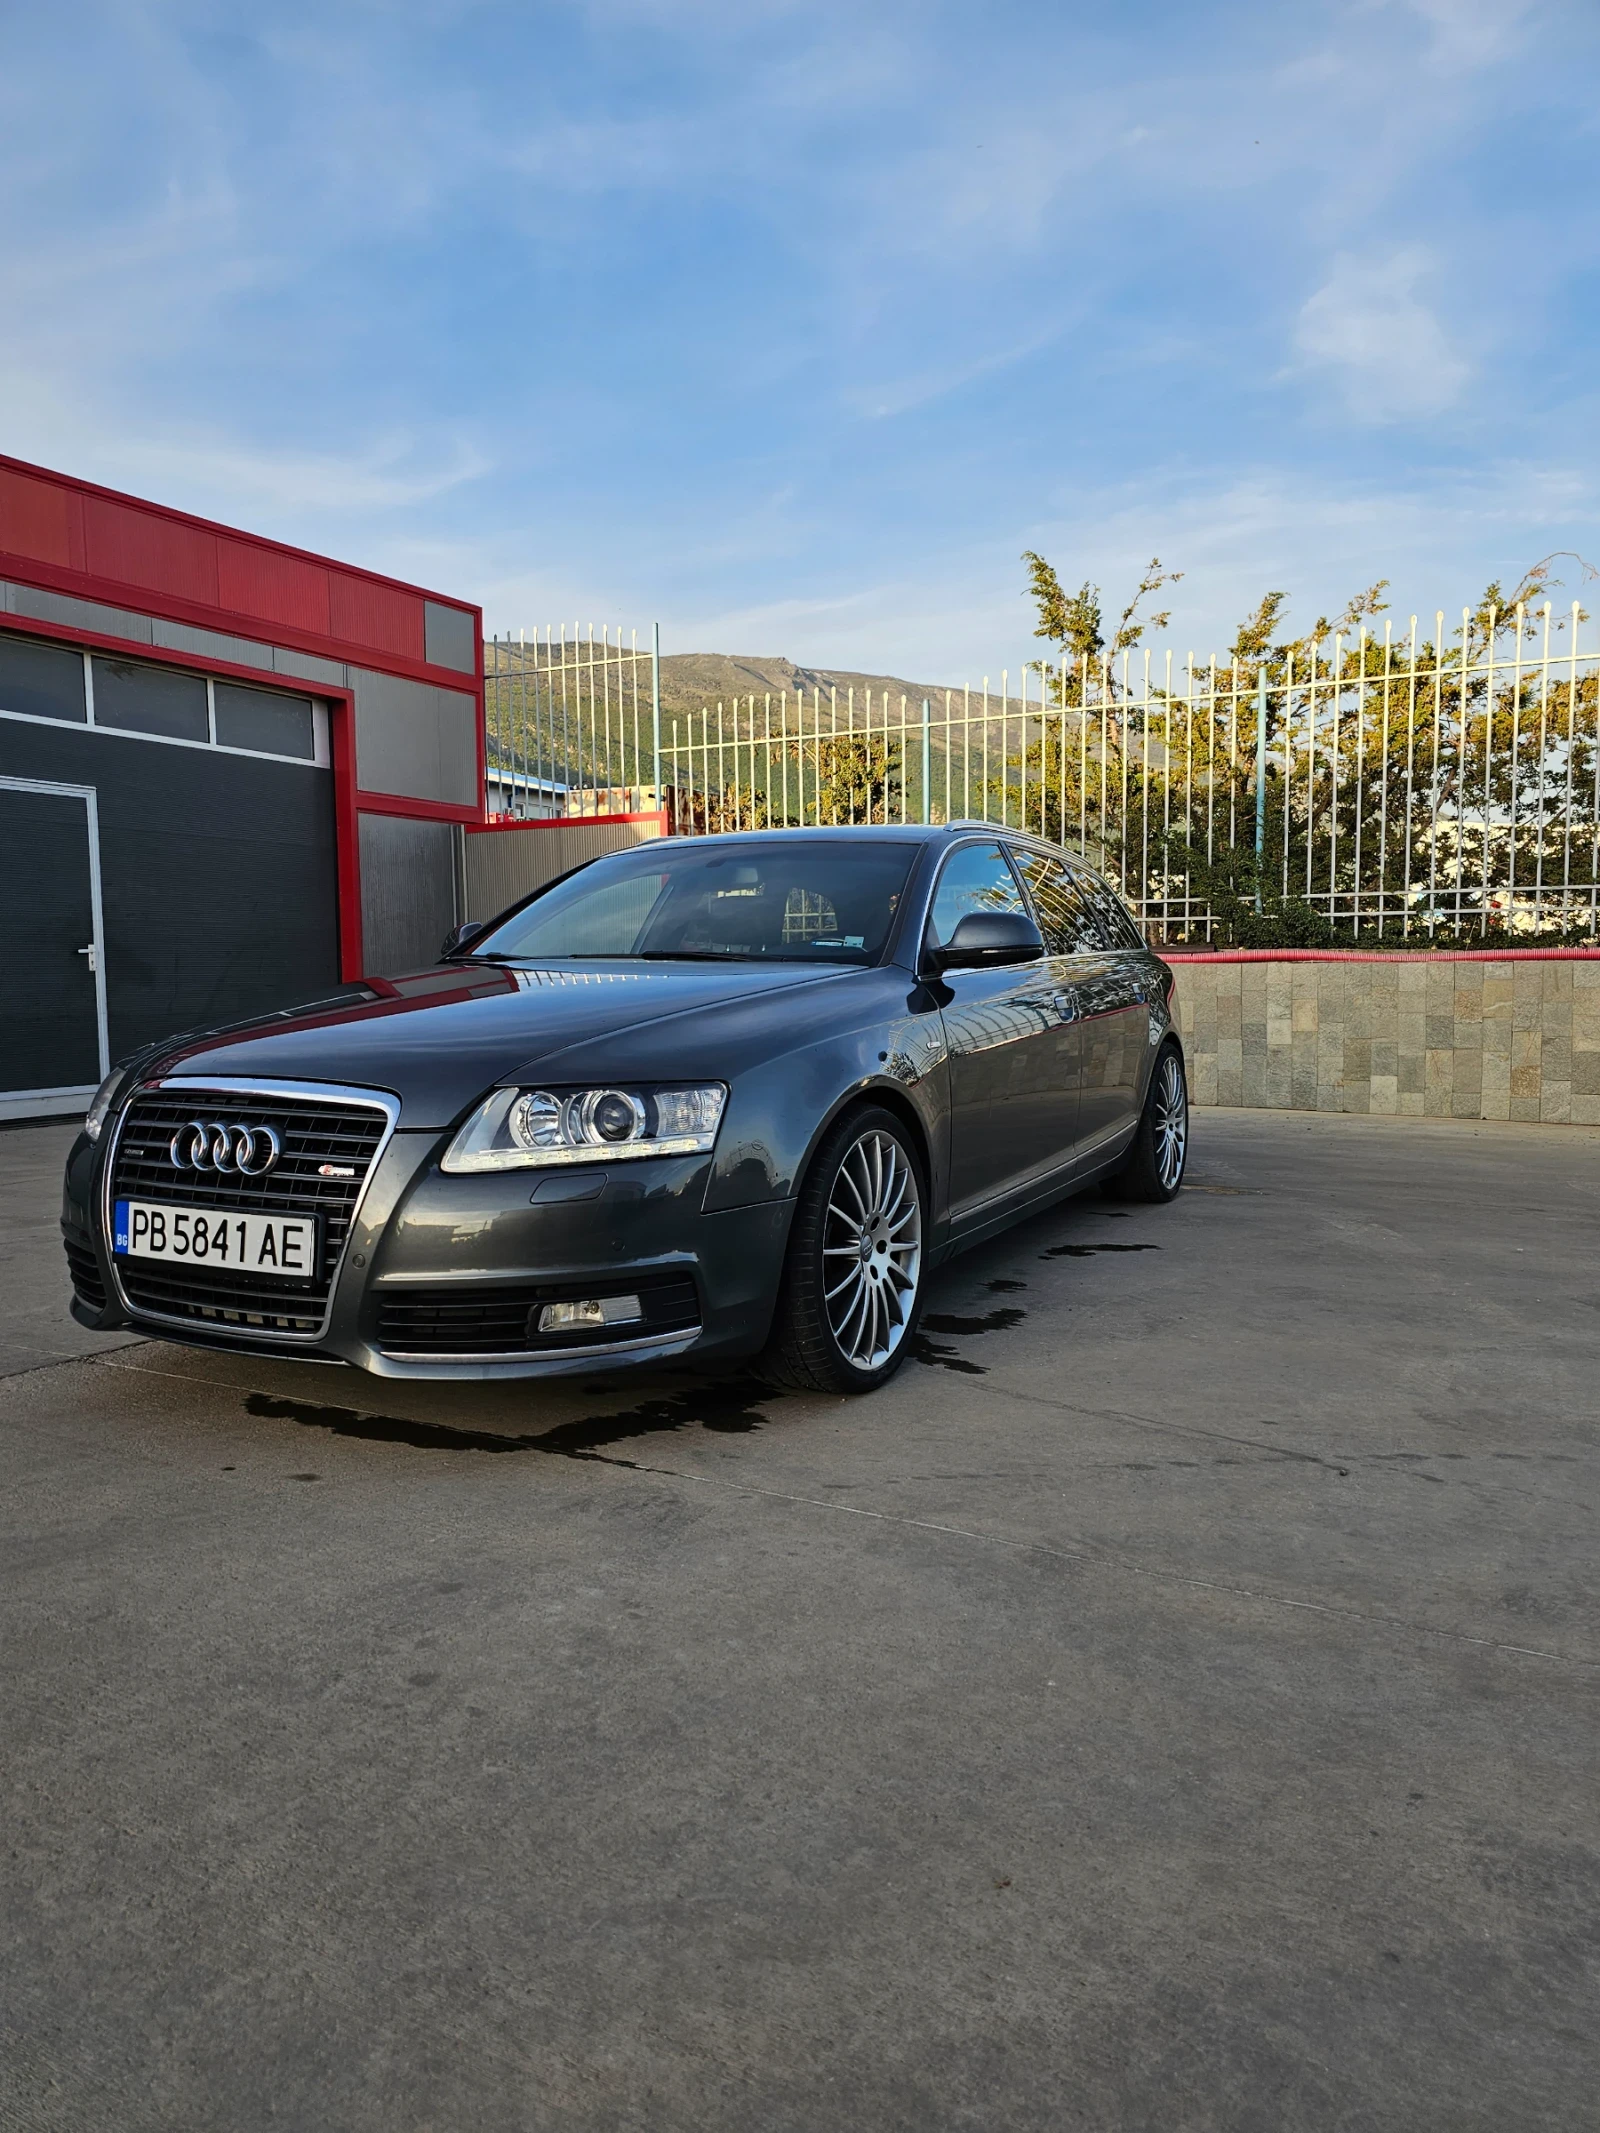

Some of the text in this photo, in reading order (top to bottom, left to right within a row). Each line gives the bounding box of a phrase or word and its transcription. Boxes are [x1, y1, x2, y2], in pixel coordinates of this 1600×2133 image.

[116, 1233, 128, 1247] BG
[132, 1209, 304, 1268] PB 5841 AE
